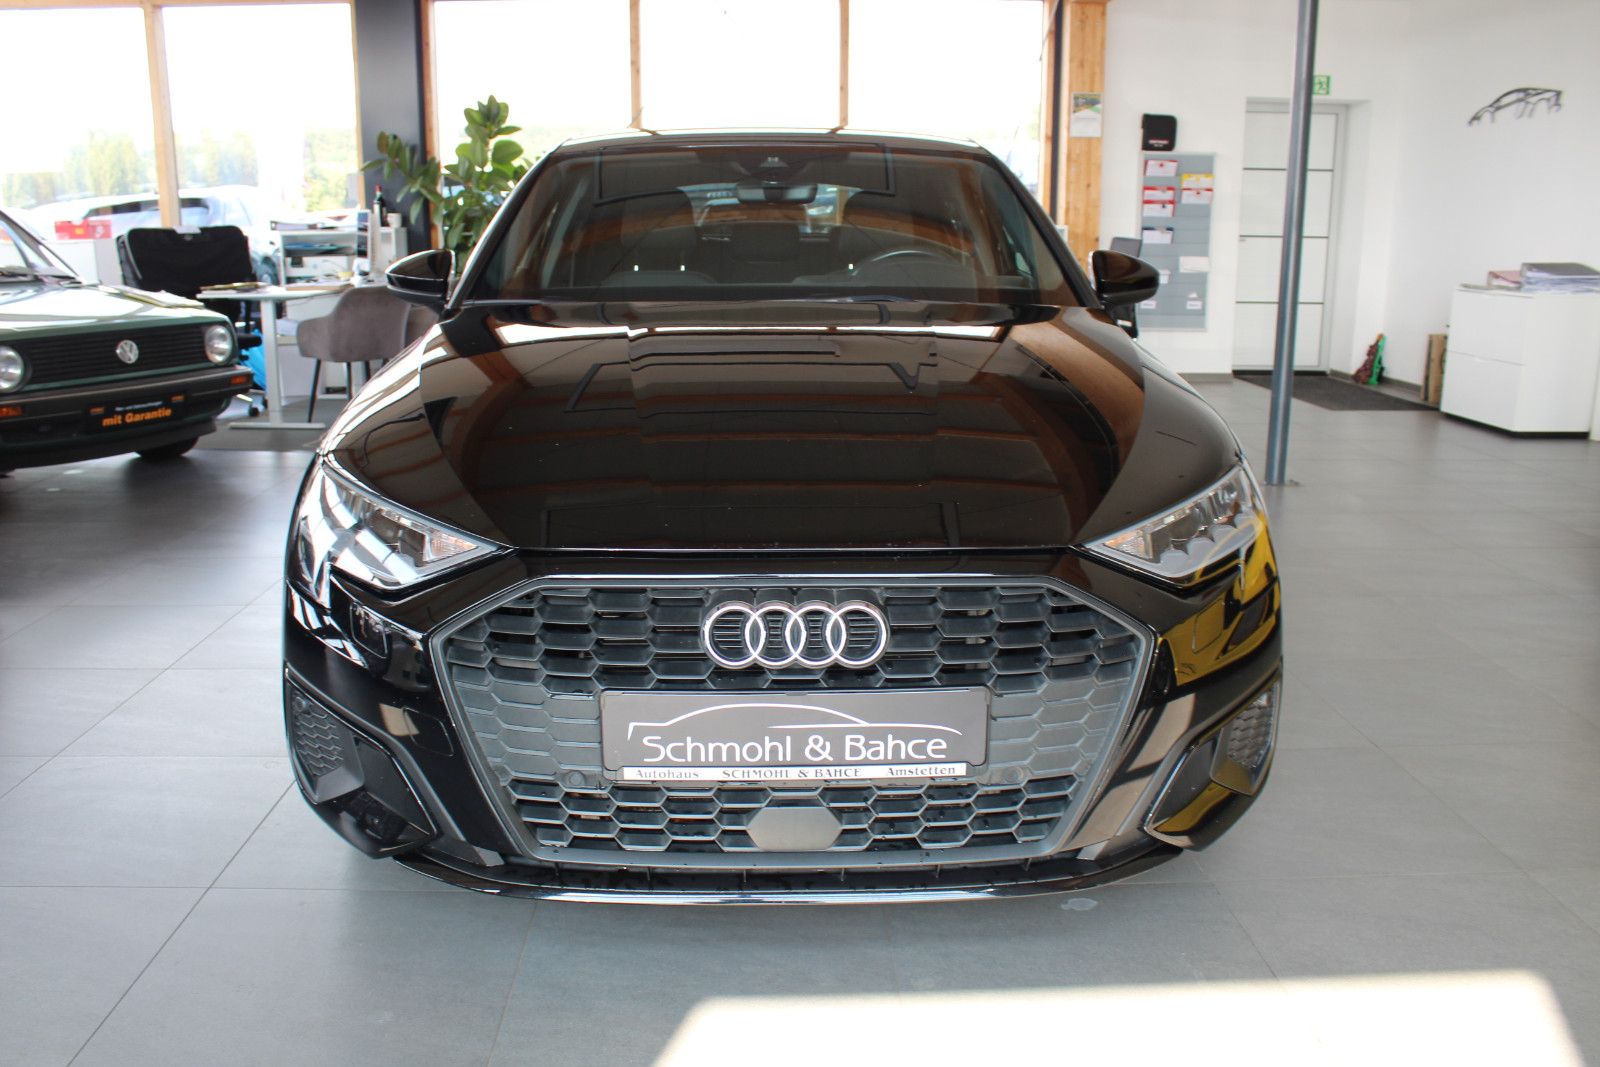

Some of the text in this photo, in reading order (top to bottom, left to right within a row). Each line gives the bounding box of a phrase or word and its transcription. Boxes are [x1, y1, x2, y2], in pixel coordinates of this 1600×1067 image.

[102, 408, 172, 427] mit Garantie
[643, 733, 947, 762] Schmohl & Bahce
[635, 766, 956, 779] Autohaus SCHMOHL & BAHCE Amstetten
